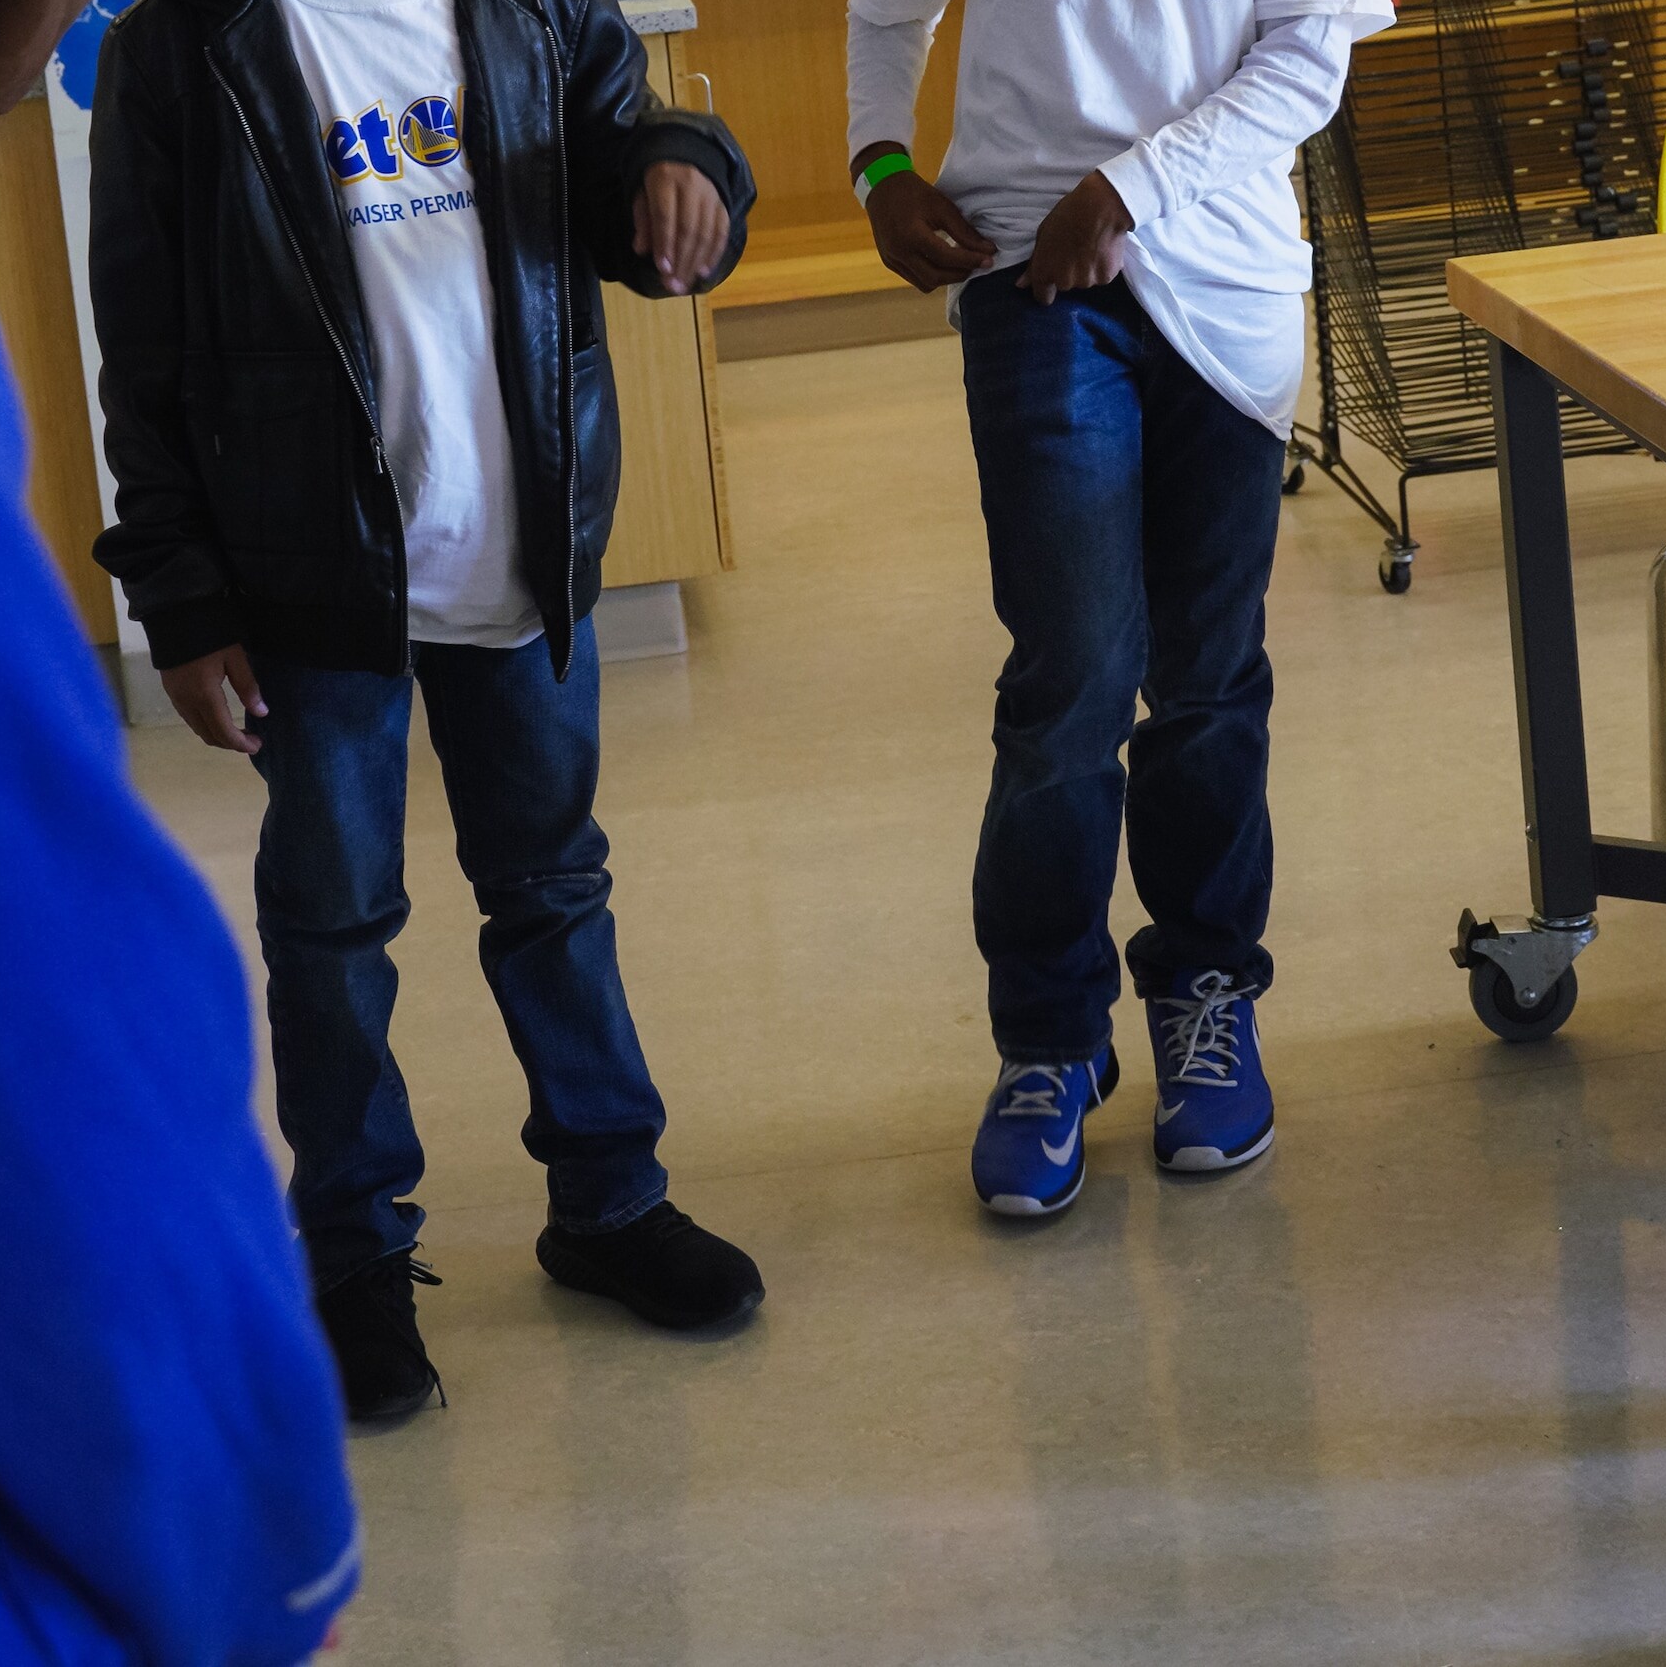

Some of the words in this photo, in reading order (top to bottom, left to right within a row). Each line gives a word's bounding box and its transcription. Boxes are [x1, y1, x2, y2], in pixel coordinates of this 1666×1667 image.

[321, 98, 404, 186] et
[345, 203, 406, 229] KAISER
[410, 190, 476, 218] PERMA
